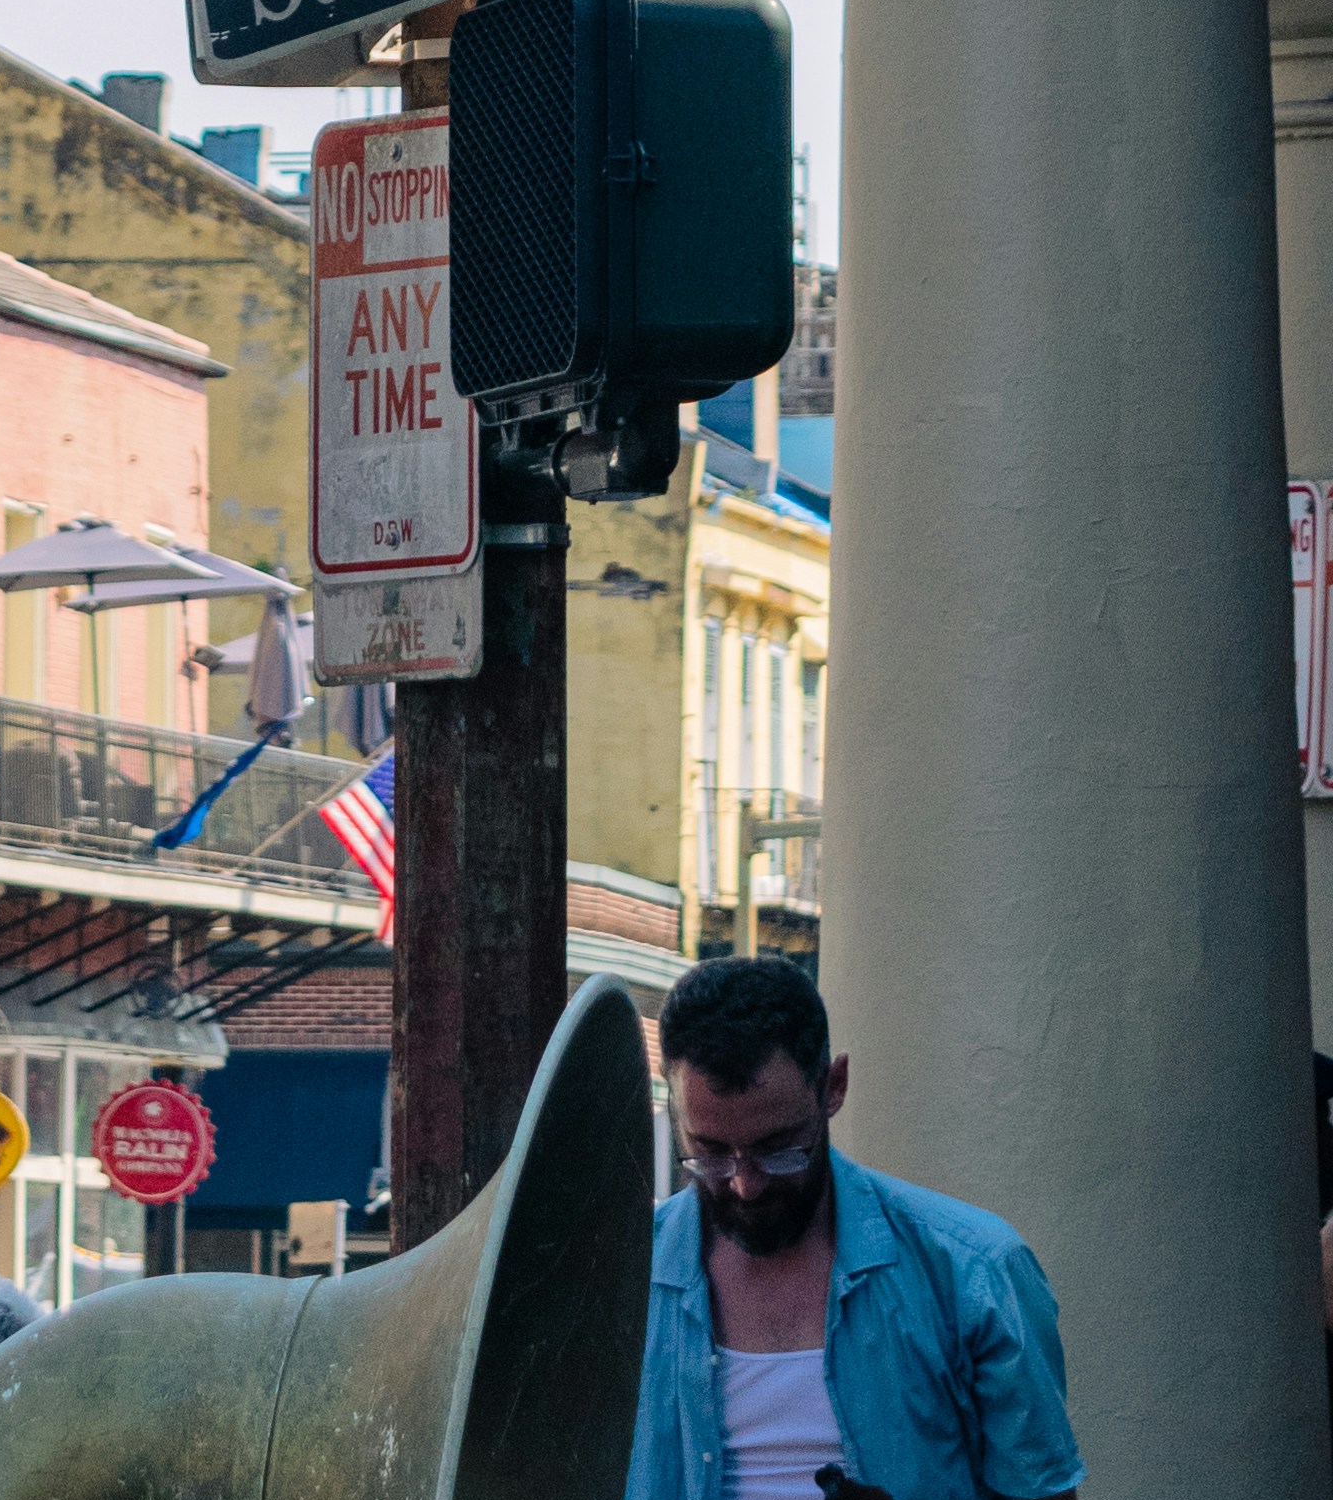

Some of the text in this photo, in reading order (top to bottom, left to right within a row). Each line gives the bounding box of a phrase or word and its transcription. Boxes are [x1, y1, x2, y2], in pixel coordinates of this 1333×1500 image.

[317, 160, 450, 245] NO STOPPIN
[346, 280, 442, 358] ANY
[344, 362, 443, 437] TIME
